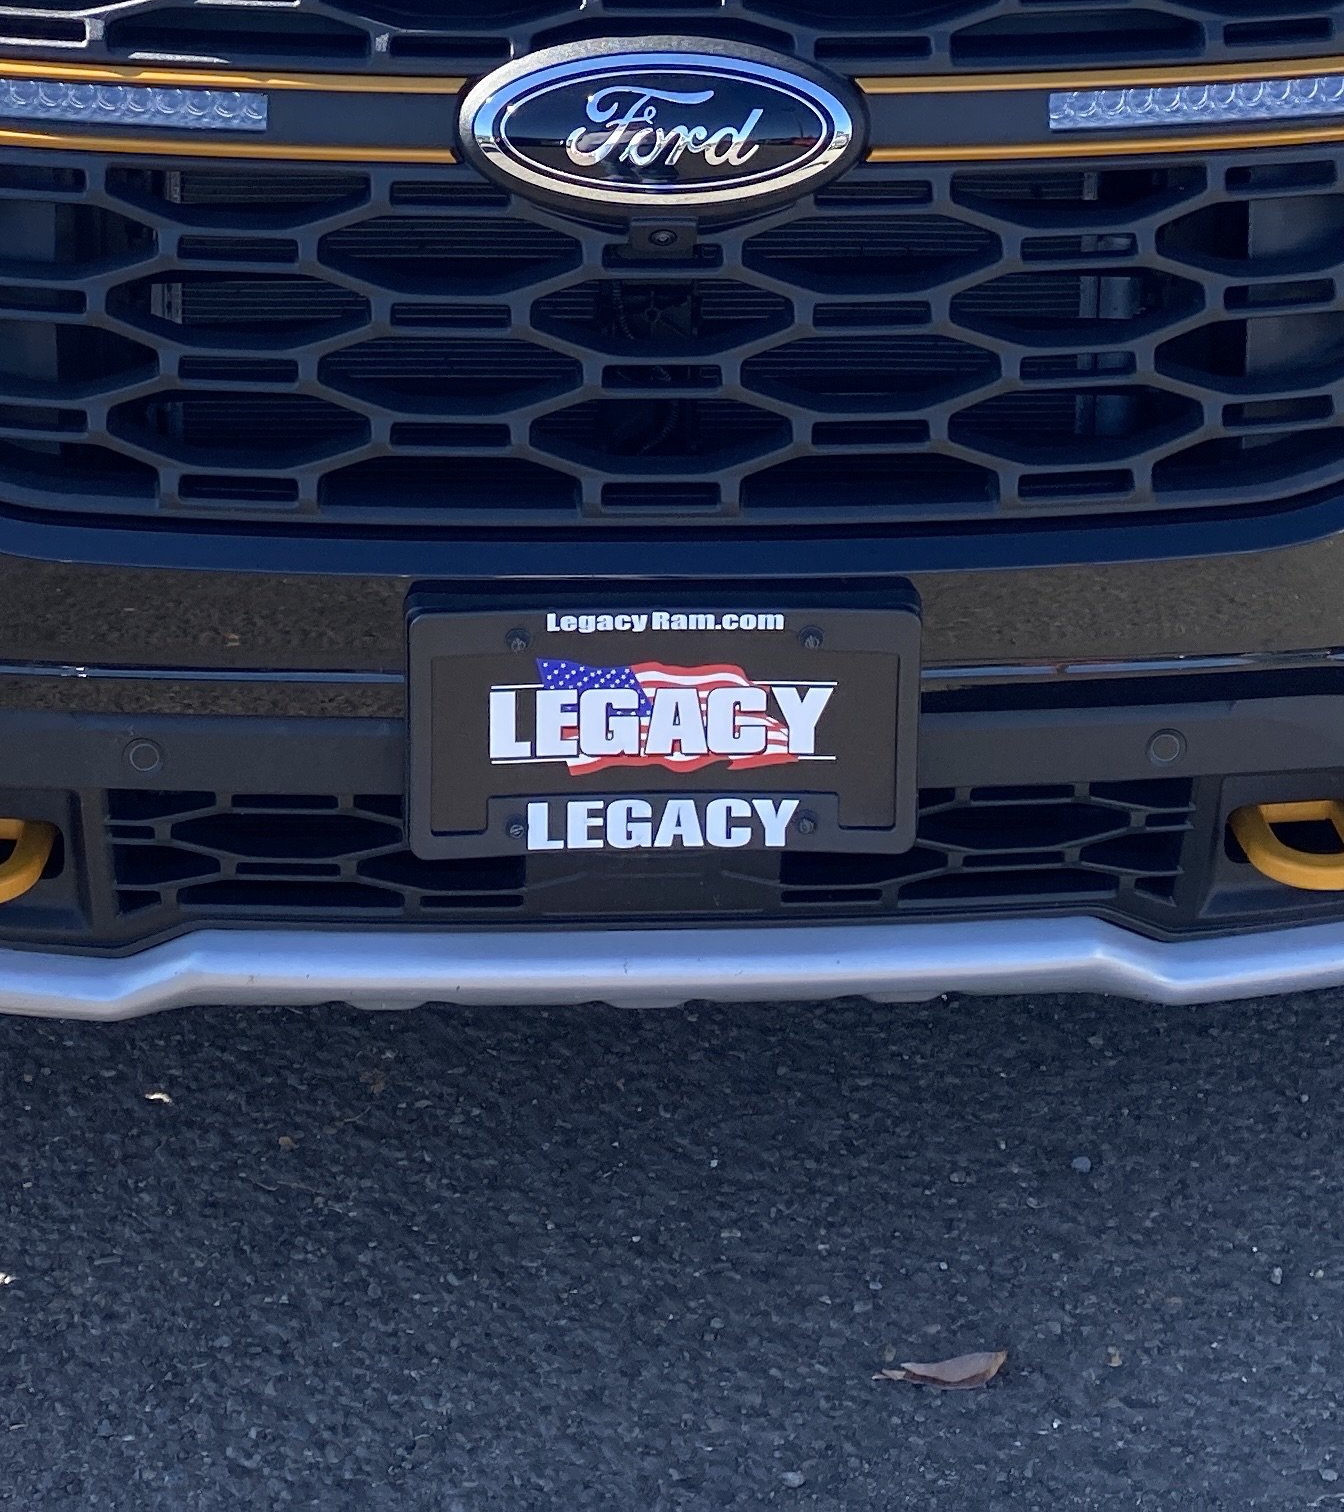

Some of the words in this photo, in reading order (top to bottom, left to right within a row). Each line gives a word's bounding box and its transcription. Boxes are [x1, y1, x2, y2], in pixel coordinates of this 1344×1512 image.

[565, 87, 764, 167] Ford
[489, 686, 835, 759] LEGACY
[527, 797, 800, 851] LEGACY
